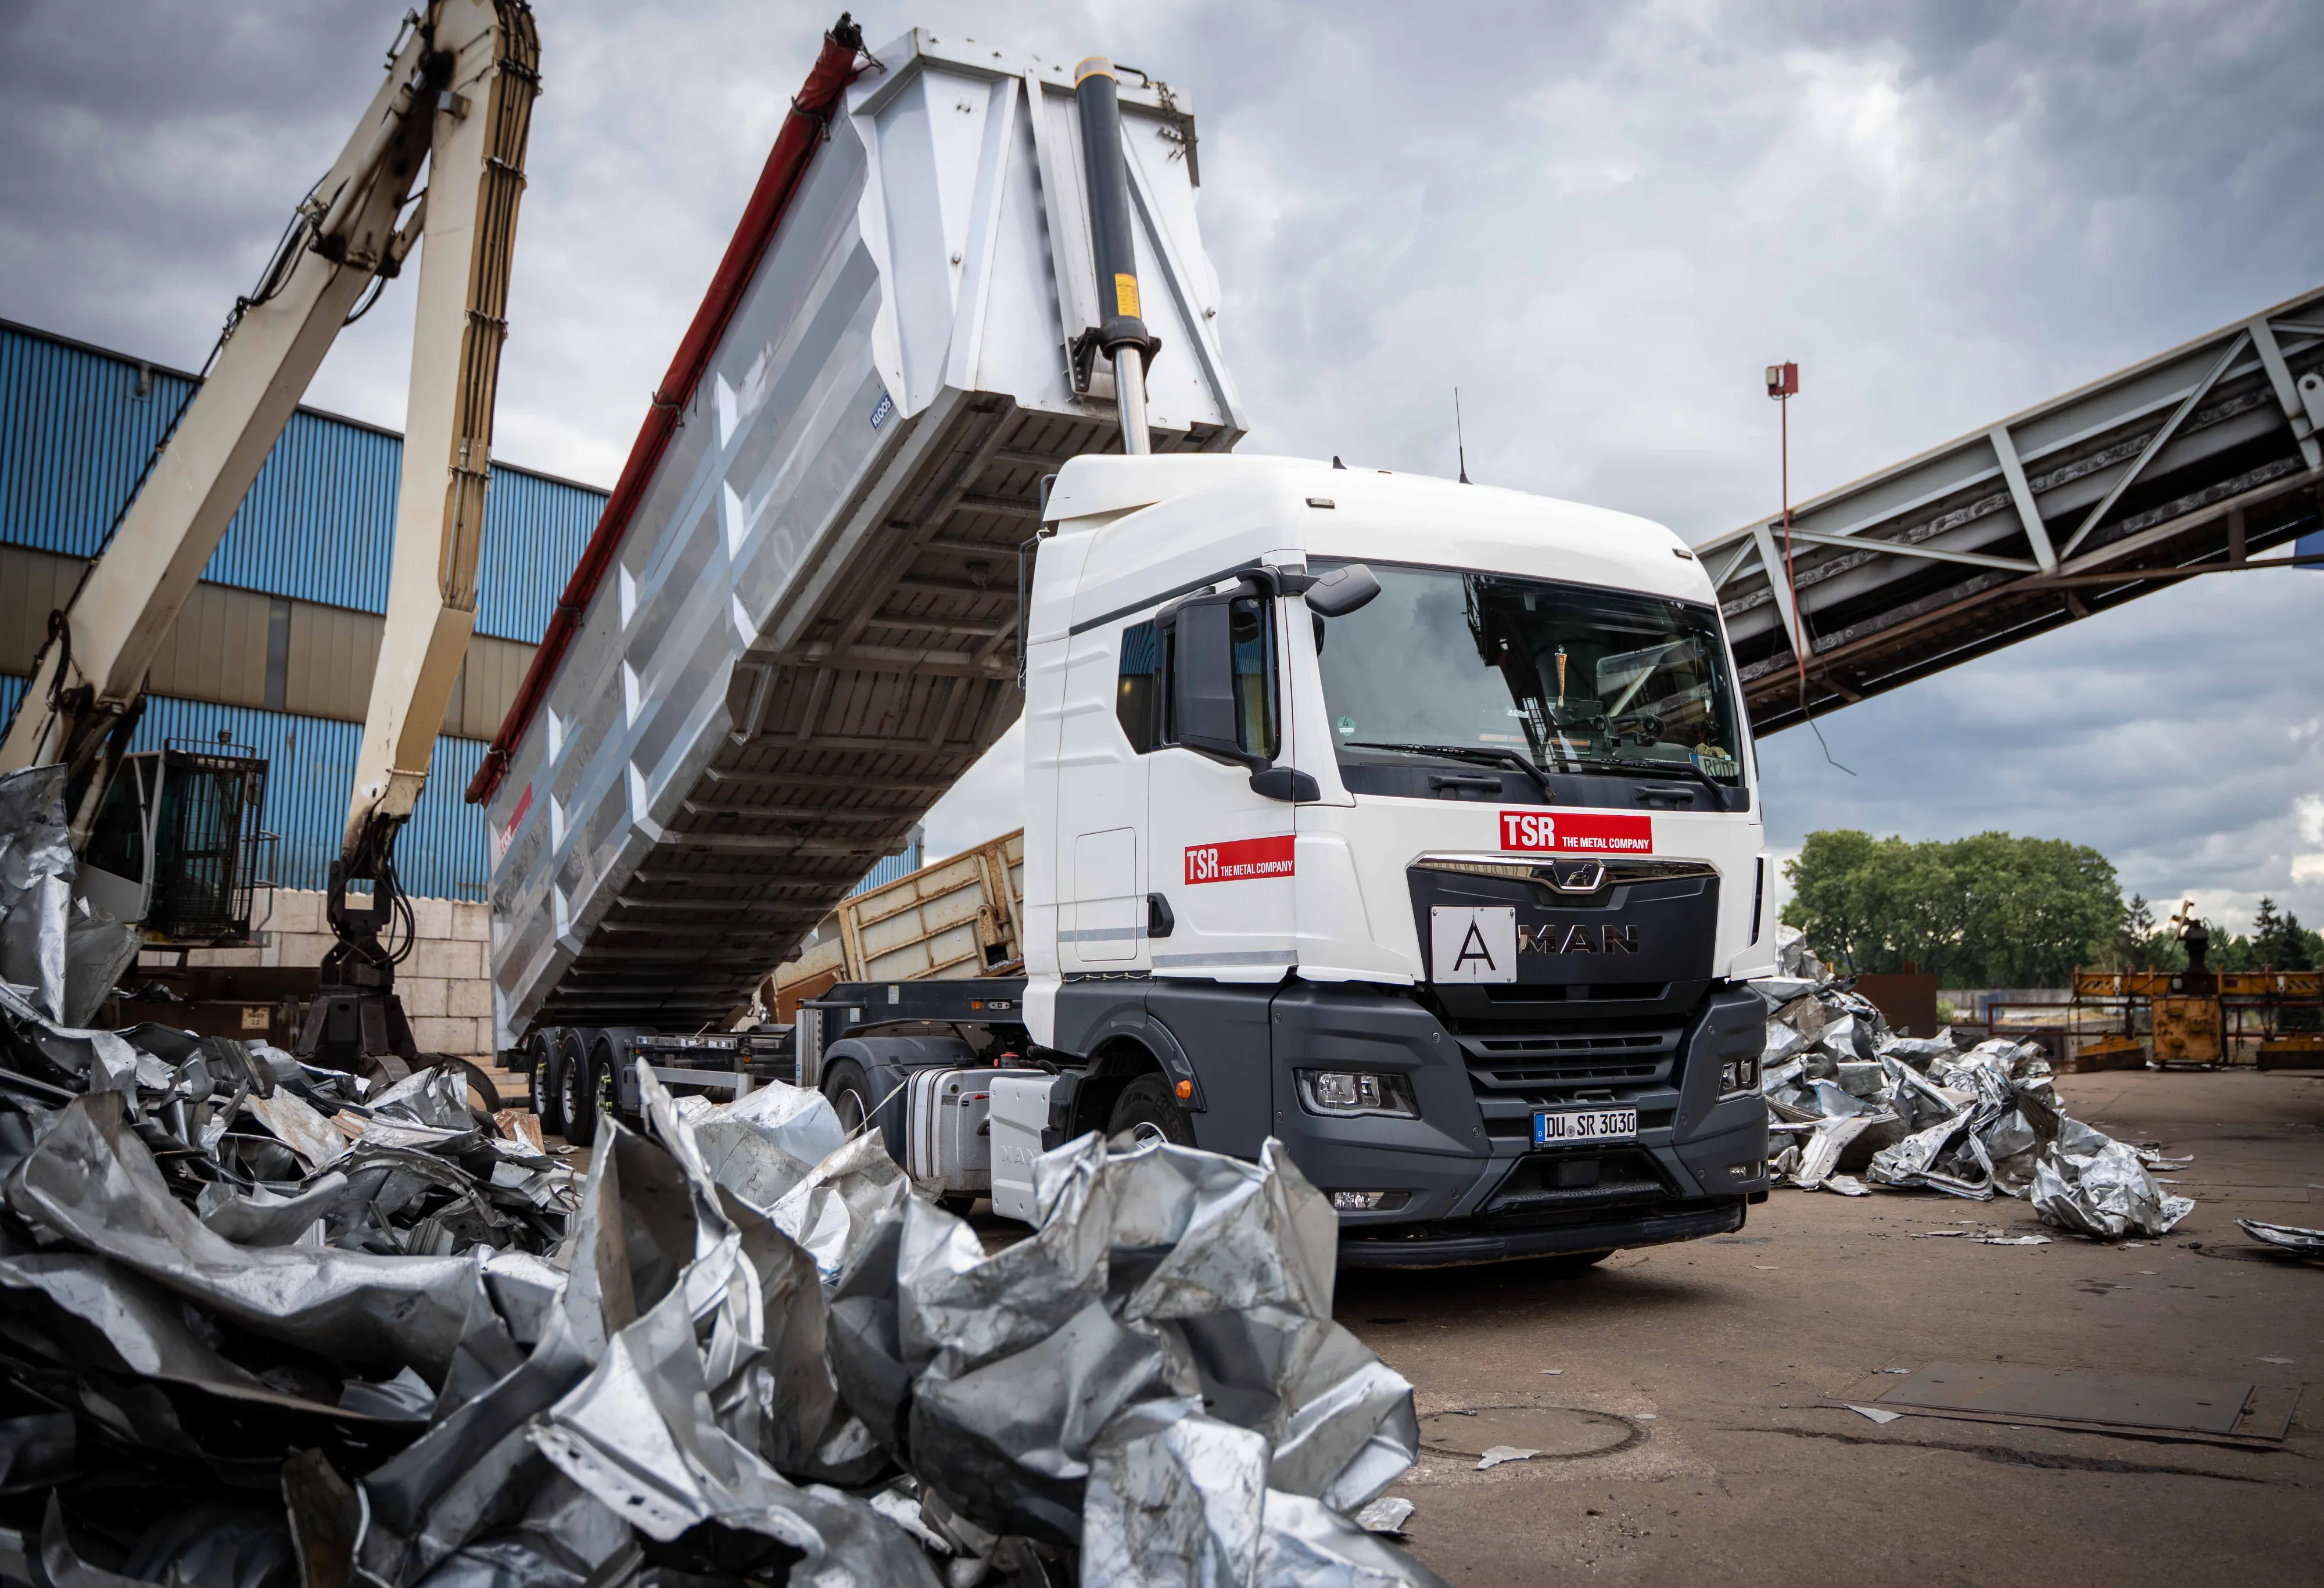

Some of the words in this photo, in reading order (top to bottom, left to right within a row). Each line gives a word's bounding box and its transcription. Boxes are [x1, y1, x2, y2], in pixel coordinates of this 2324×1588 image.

[871, 397, 891, 427] KLOOS
[1504, 815, 1555, 847] TSR
[1562, 837, 1579, 847] THE
[1580, 837, 1608, 848] METAL
[1609, 838, 1649, 849] COMPANY
[1186, 848, 1218, 880] TSR
[1220, 865, 1232, 877] THE
[1233, 863, 1255, 876] METAL
[1256, 860, 1293, 874] COMPANY
[1453, 920, 1496, 971] A
[1518, 924, 1640, 954] MAN
[1546, 1116, 1565, 1138] DU
[1577, 1114, 1595, 1136] SR
[1599, 1112, 1635, 1134] 3030
[1000, 1145, 1038, 1166] MAN
